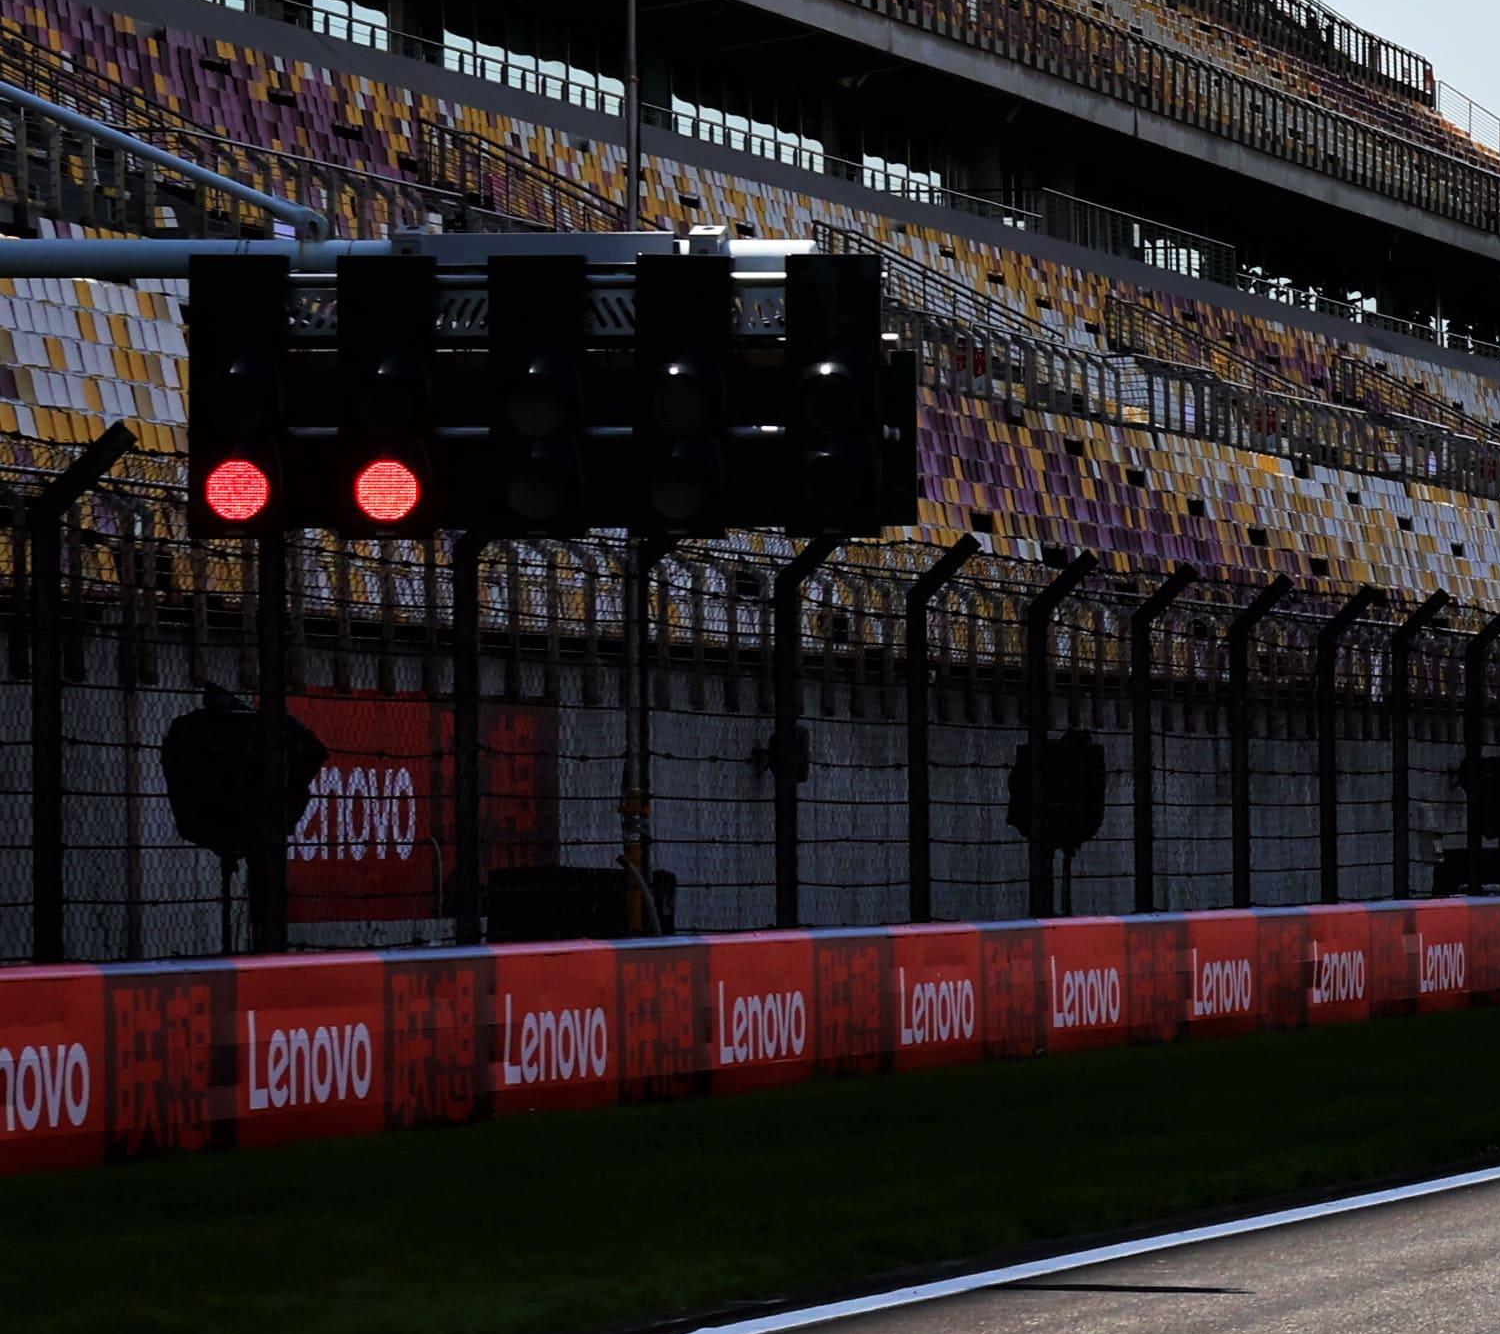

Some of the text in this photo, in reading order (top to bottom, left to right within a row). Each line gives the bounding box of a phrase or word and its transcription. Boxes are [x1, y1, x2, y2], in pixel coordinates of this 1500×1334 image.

[286, 766, 417, 861] enovo
[1050, 955, 1120, 1028] Lenovo
[1192, 948, 1252, 1016] Lenovo
[1312, 940, 1365, 1004] Lenovo
[1419, 932, 1465, 993] Lenovo
[391, 969, 475, 1127] 联想
[503, 993, 607, 1085] Lenovo
[718, 980, 806, 1065] Lenovo
[899, 967, 974, 1046] Lenovo
[113, 985, 211, 1155] 联想
[248, 1010, 372, 1110] Lenovo
